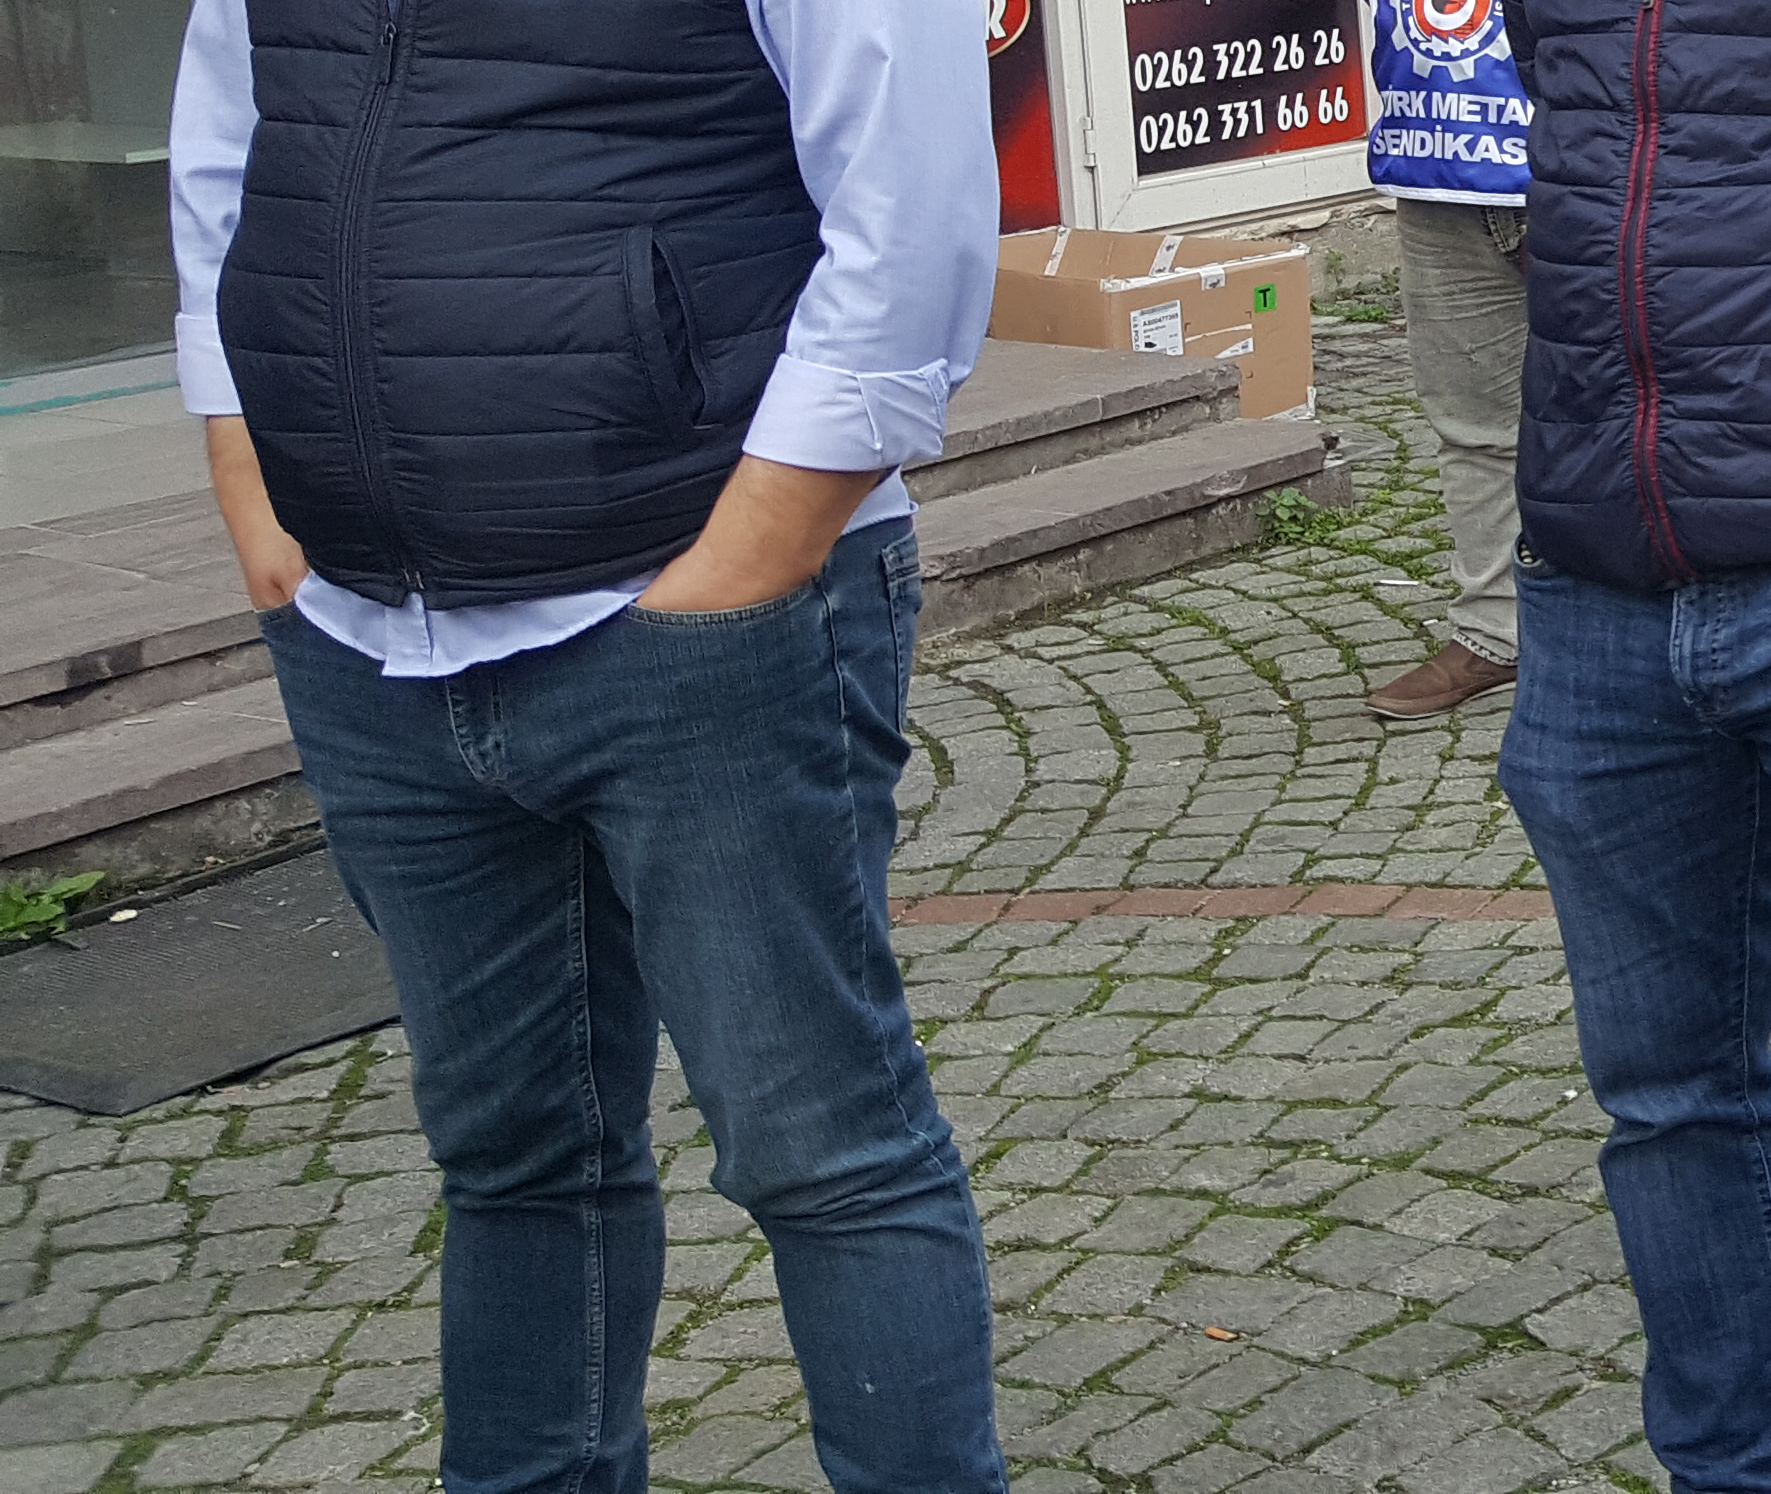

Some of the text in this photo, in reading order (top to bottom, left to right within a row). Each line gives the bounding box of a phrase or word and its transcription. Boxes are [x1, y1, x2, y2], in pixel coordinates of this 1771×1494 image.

[1134, 28, 1345, 92] 0262 322 26 26
[1139, 86, 1349, 153] 0262 331 66 66
[1372, 124, 1528, 166] SENDİKAS
[1258, 287, 1271, 308] T
